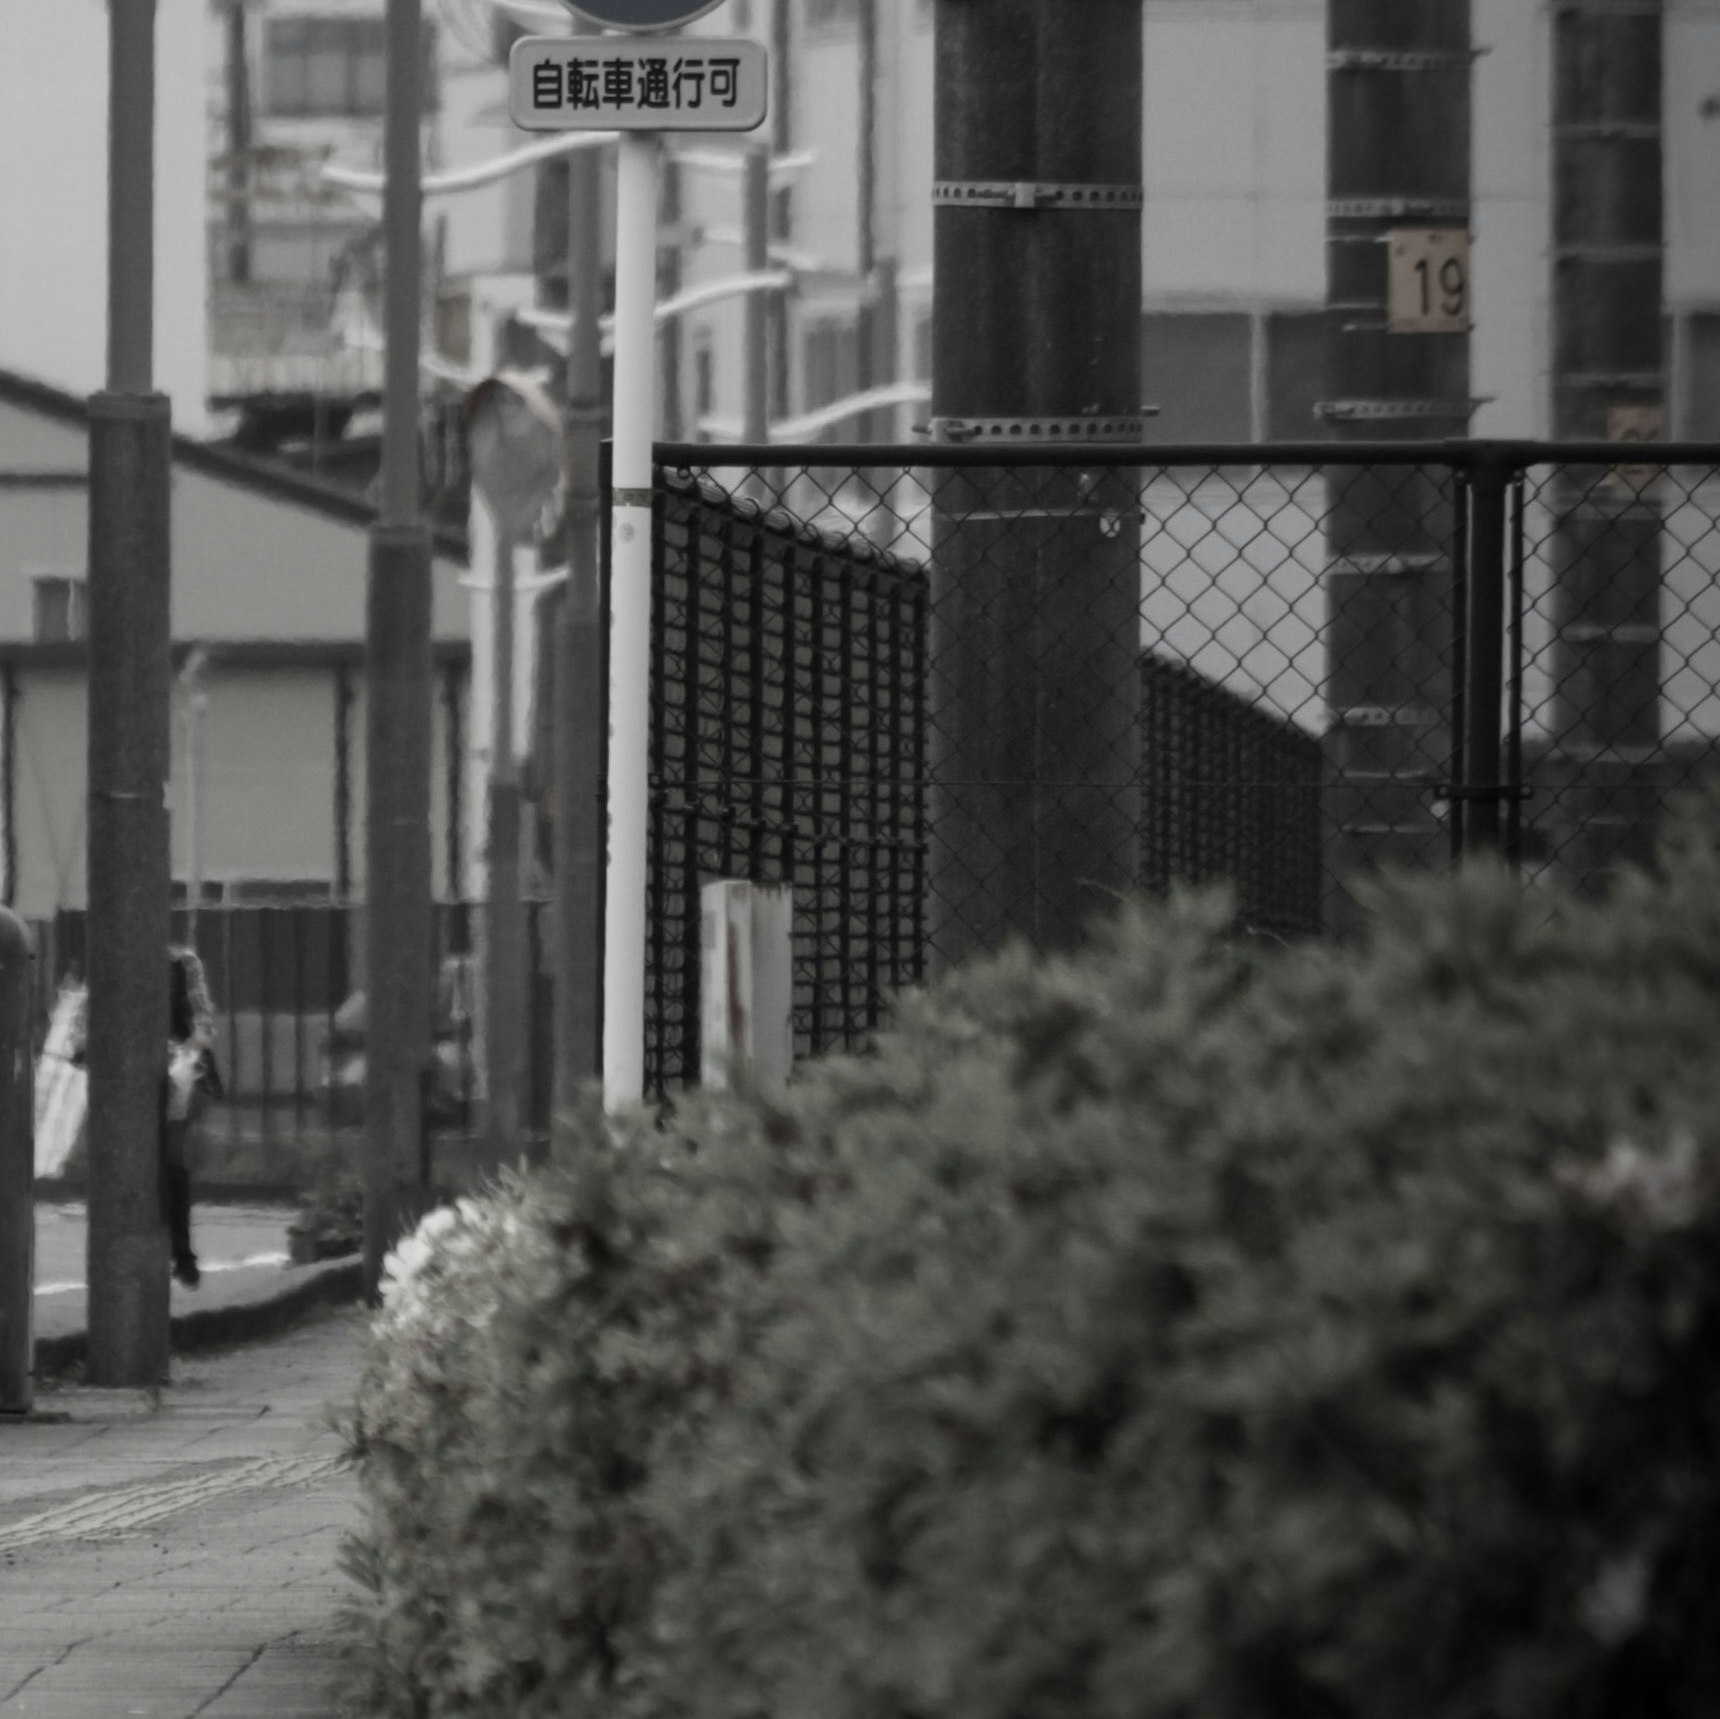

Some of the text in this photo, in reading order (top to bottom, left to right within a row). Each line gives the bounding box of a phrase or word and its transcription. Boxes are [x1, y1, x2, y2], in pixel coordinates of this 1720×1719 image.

[532, 57, 741, 110] 自転車通行可
[1415, 257, 1464, 316] 19
